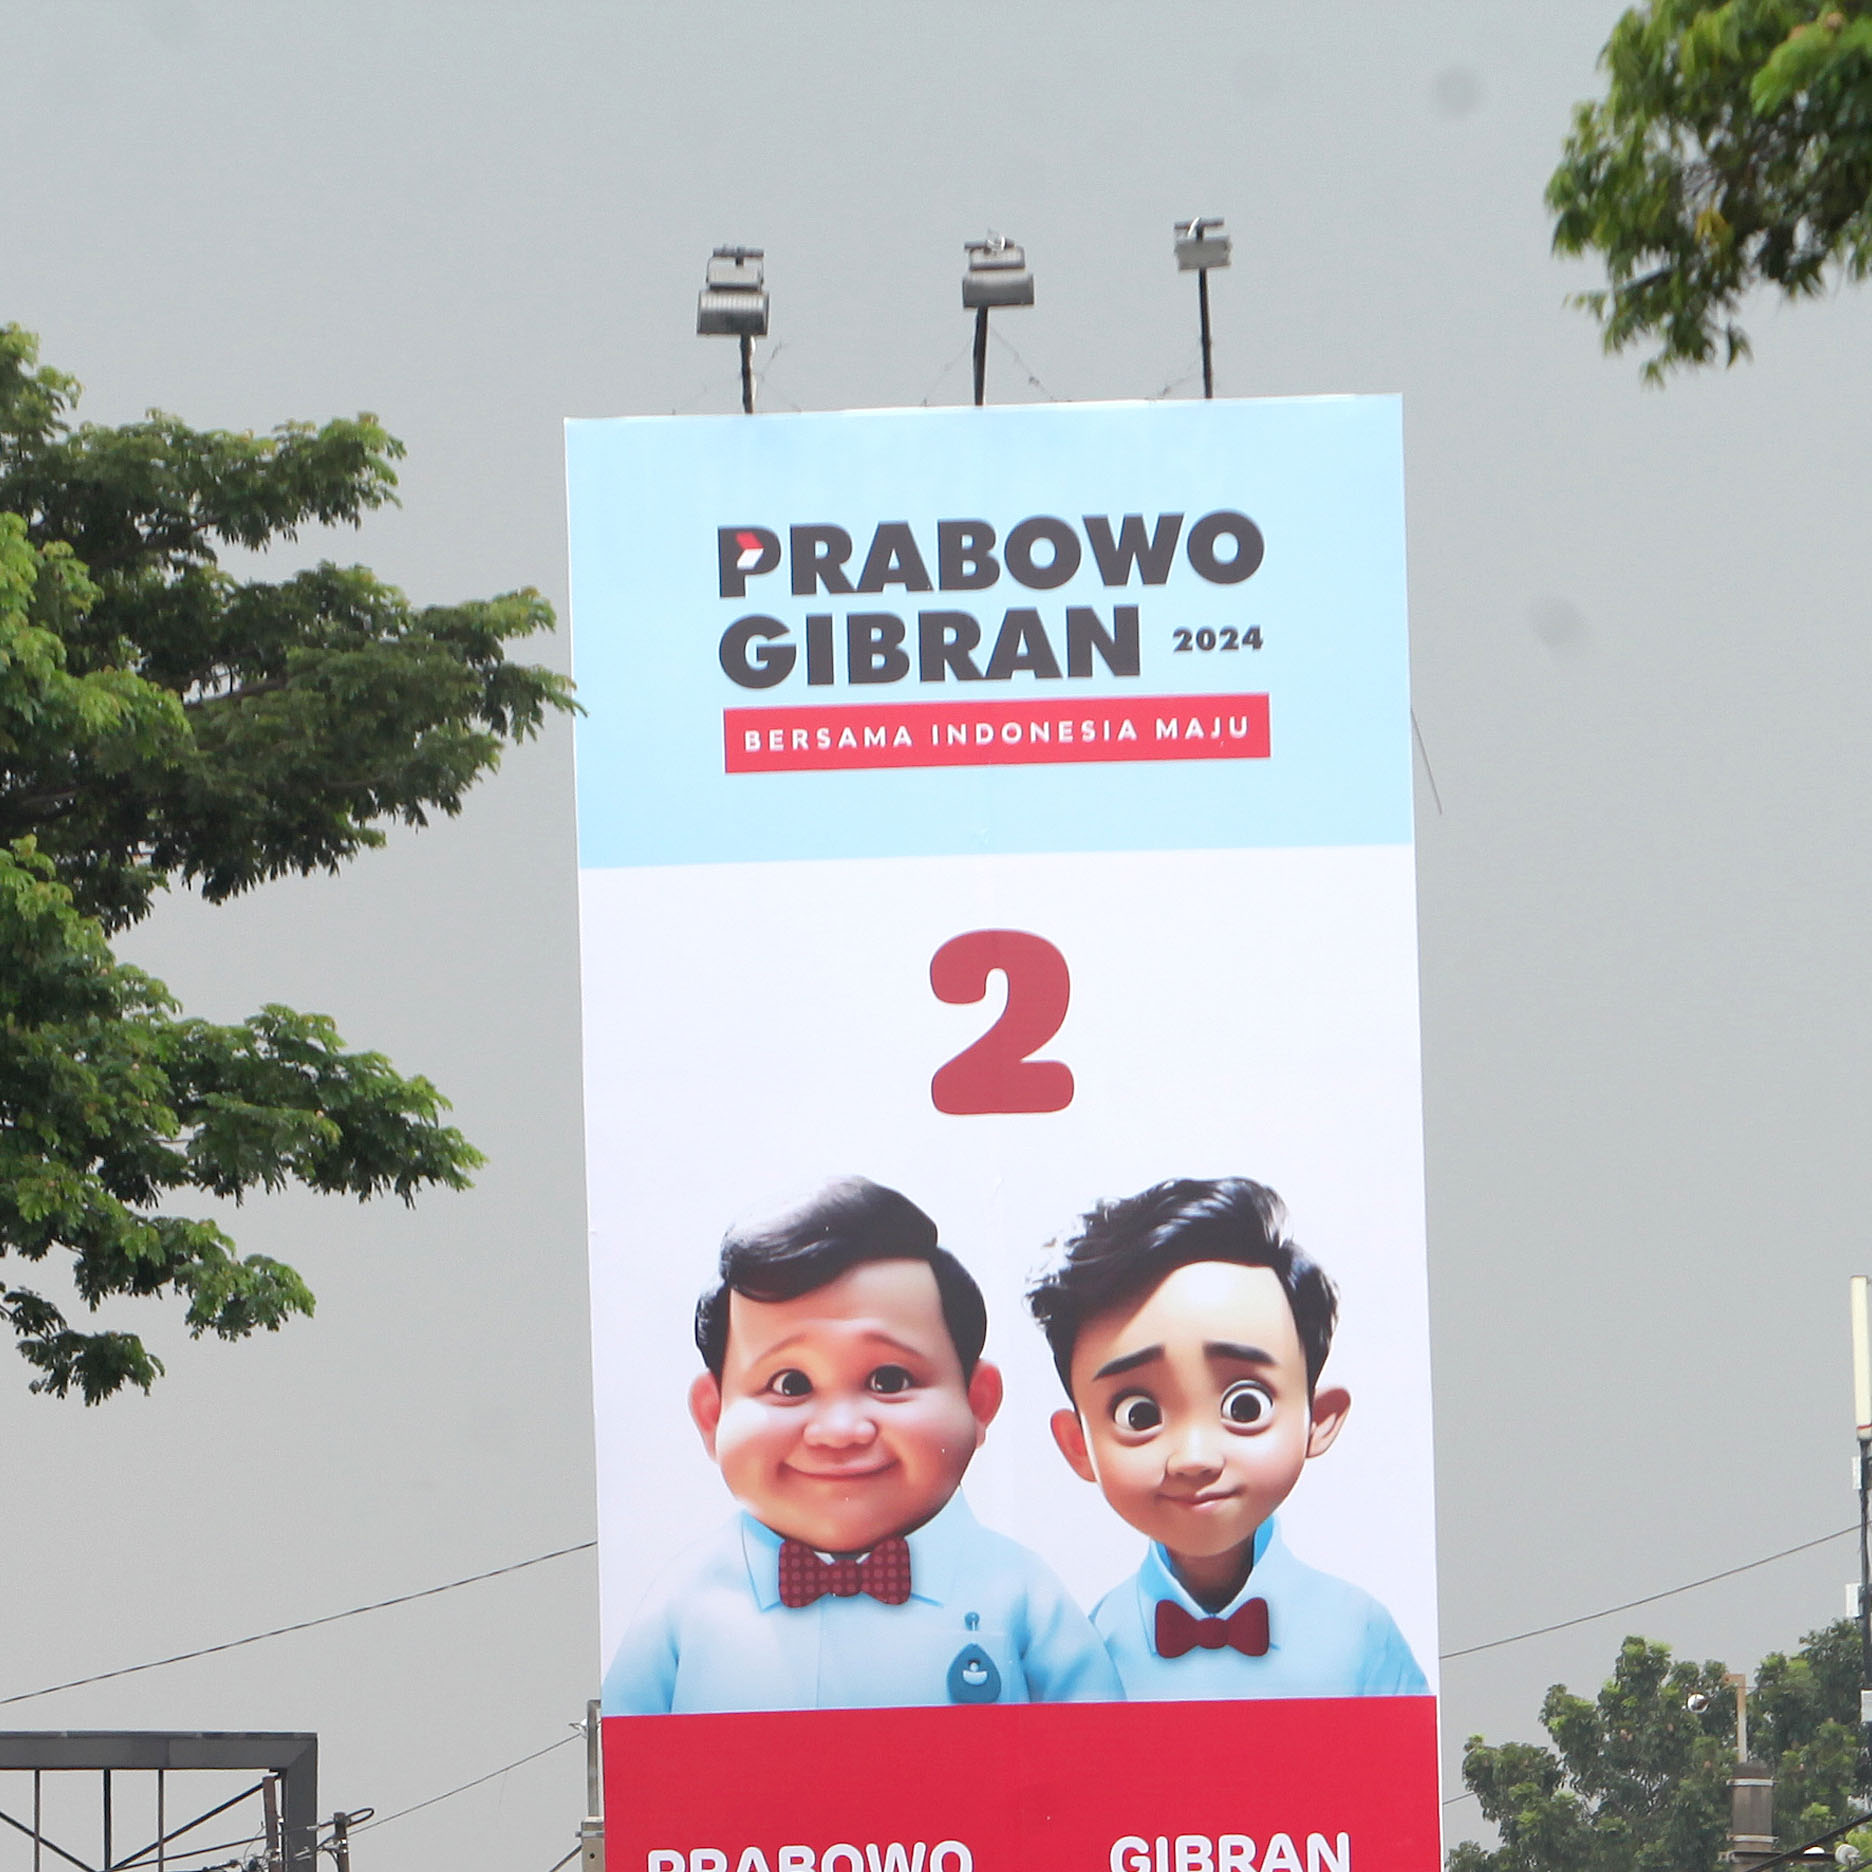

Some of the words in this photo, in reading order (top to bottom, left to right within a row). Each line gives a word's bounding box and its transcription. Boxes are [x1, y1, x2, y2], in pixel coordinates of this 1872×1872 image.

[718, 509, 1265, 598] PRABOWO
[718, 603, 1141, 690] GIBRAN
[1172, 625, 1265, 654] 2024
[743, 724, 914, 753] BERSAMA
[929, 718, 1138, 747] INDONESIA
[1155, 715, 1250, 742] MAJU
[929, 928, 1075, 1116] 2
